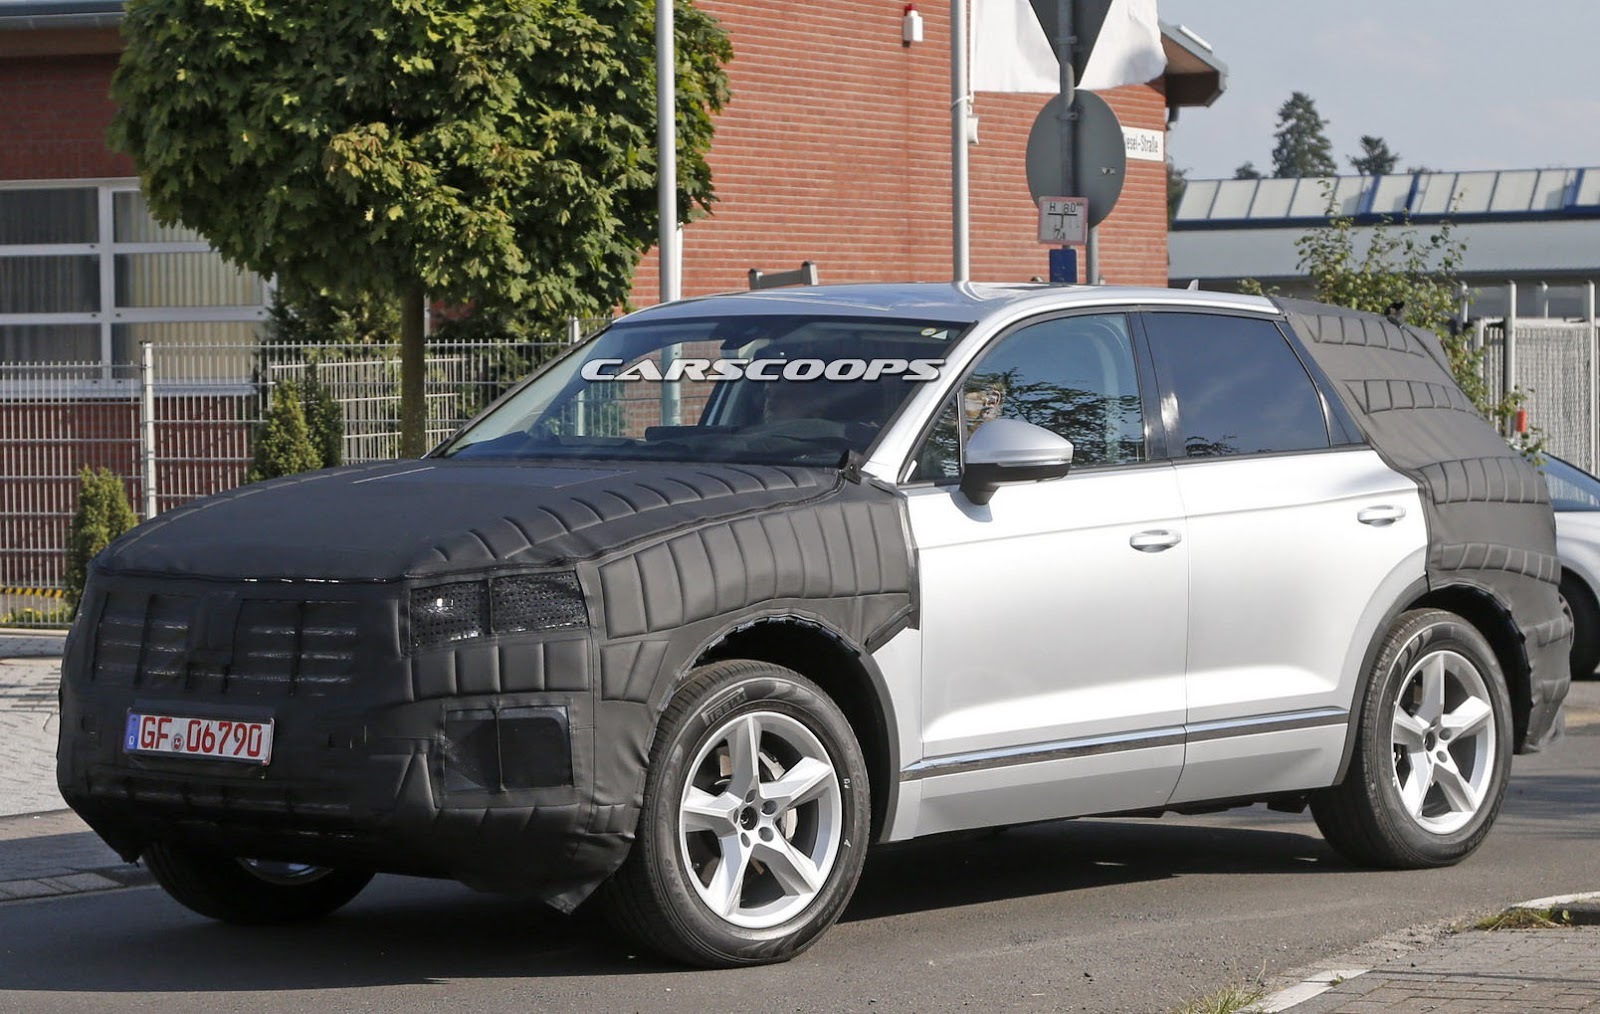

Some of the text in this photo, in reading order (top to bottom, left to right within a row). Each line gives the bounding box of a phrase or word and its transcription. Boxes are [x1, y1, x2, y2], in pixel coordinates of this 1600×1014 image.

[1125, 134, 1158, 153] esel-Straße
[1049, 202, 1056, 212] H
[701, 687, 748, 726] PIRELLI
[140, 716, 262, 757] GF 06790
